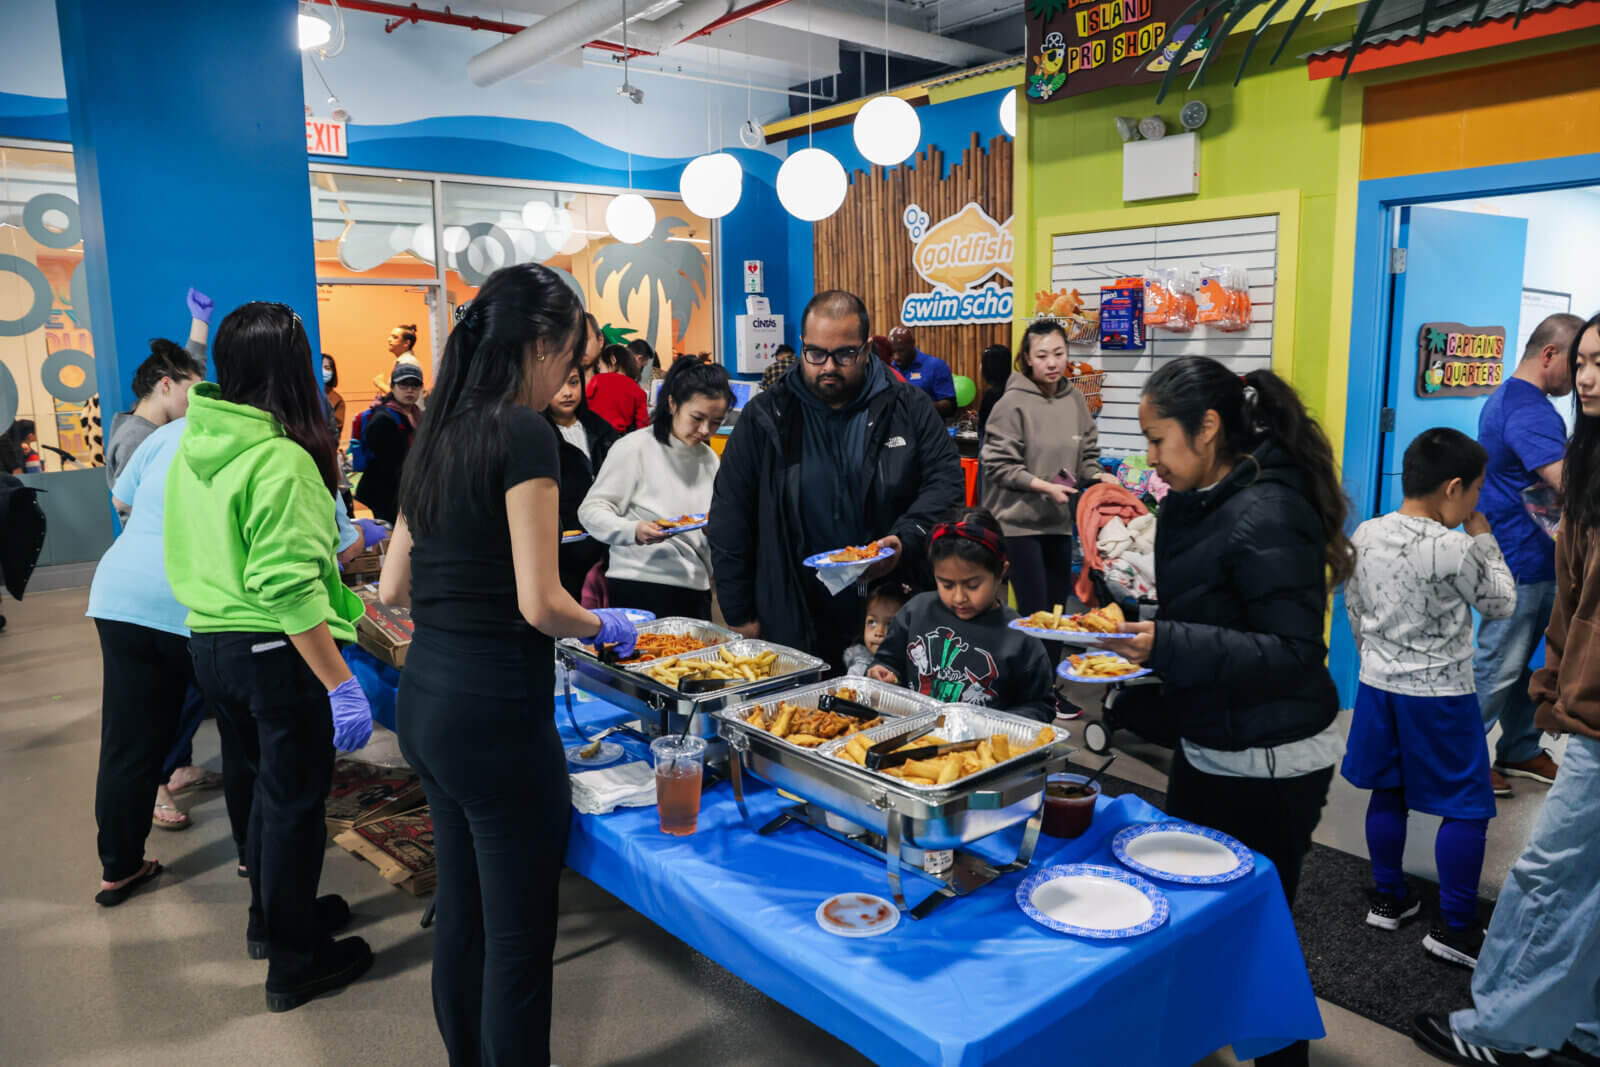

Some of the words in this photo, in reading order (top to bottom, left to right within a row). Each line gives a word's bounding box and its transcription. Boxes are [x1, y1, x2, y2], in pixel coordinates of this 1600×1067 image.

[1082, 0, 1150, 34] ISLAND
[1070, 42, 1105, 70] PRO
[1114, 25, 1164, 58] SHOP
[923, 234, 1013, 271] goldfish
[904, 291, 958, 319] swim
[961, 287, 1012, 317] scho
[1446, 364, 1503, 382] QUARTERS
